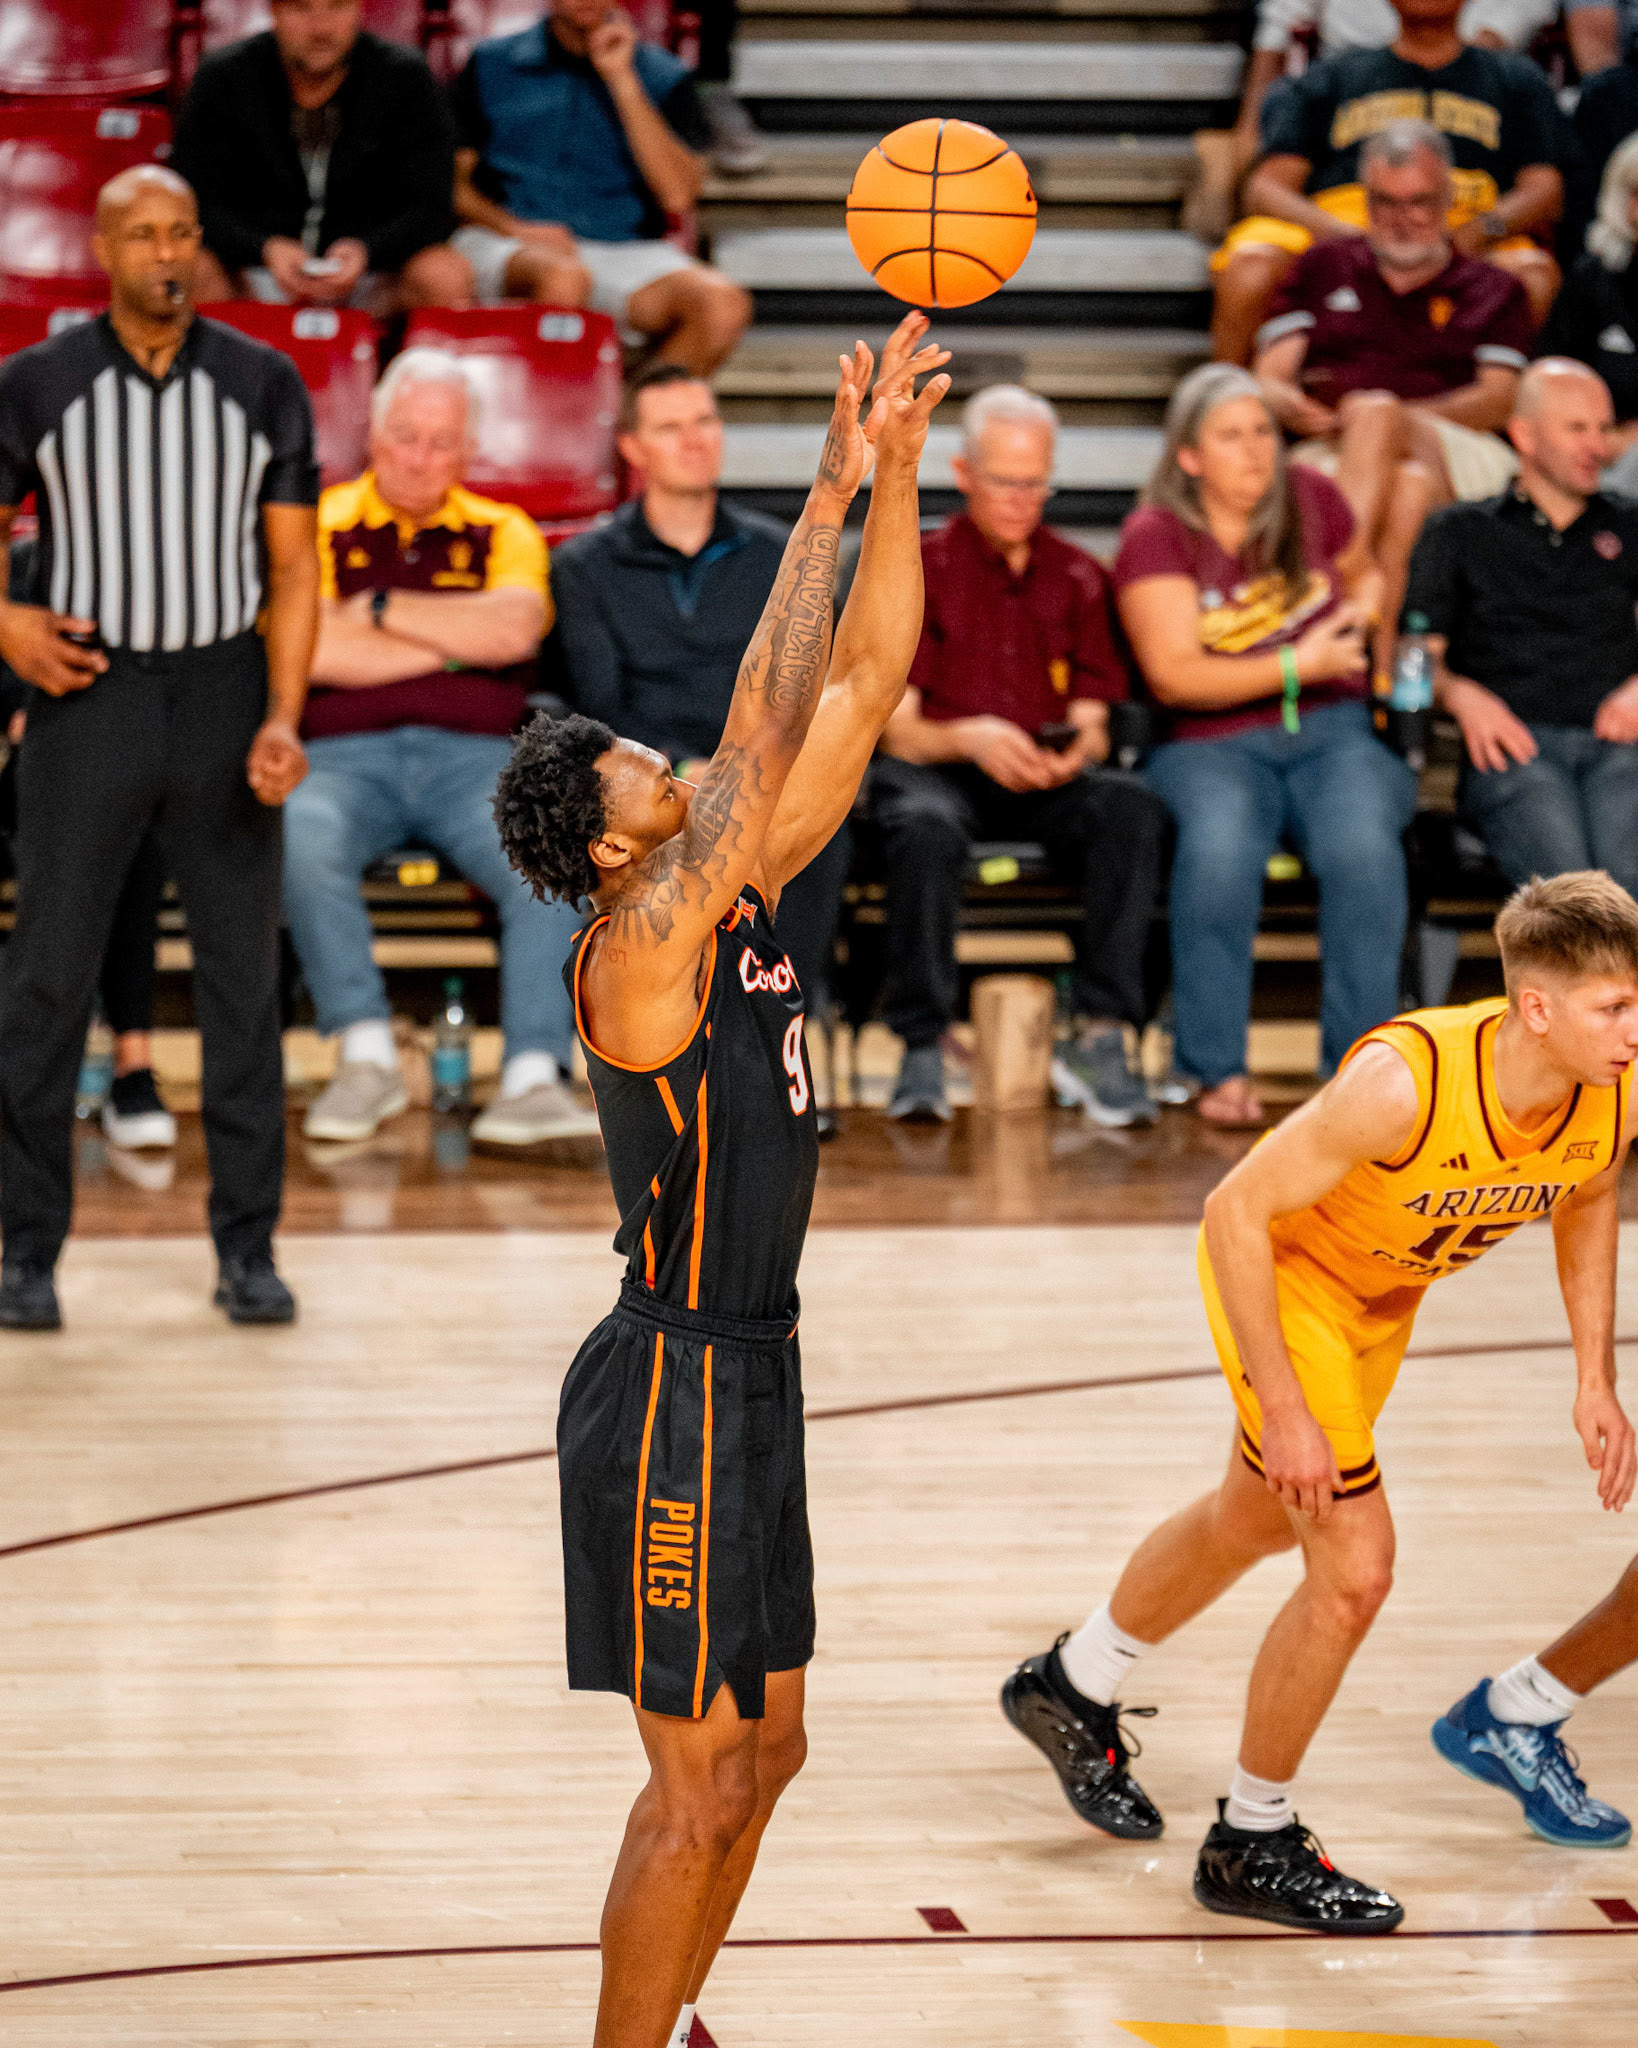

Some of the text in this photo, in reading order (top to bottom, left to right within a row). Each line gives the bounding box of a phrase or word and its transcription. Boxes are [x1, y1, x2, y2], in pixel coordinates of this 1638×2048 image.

[769, 528, 840, 709] OAKLAND
[782, 1012, 809, 1116] 9
[1408, 1221, 1524, 1264] 15
[647, 1498, 696, 1610] POKES
